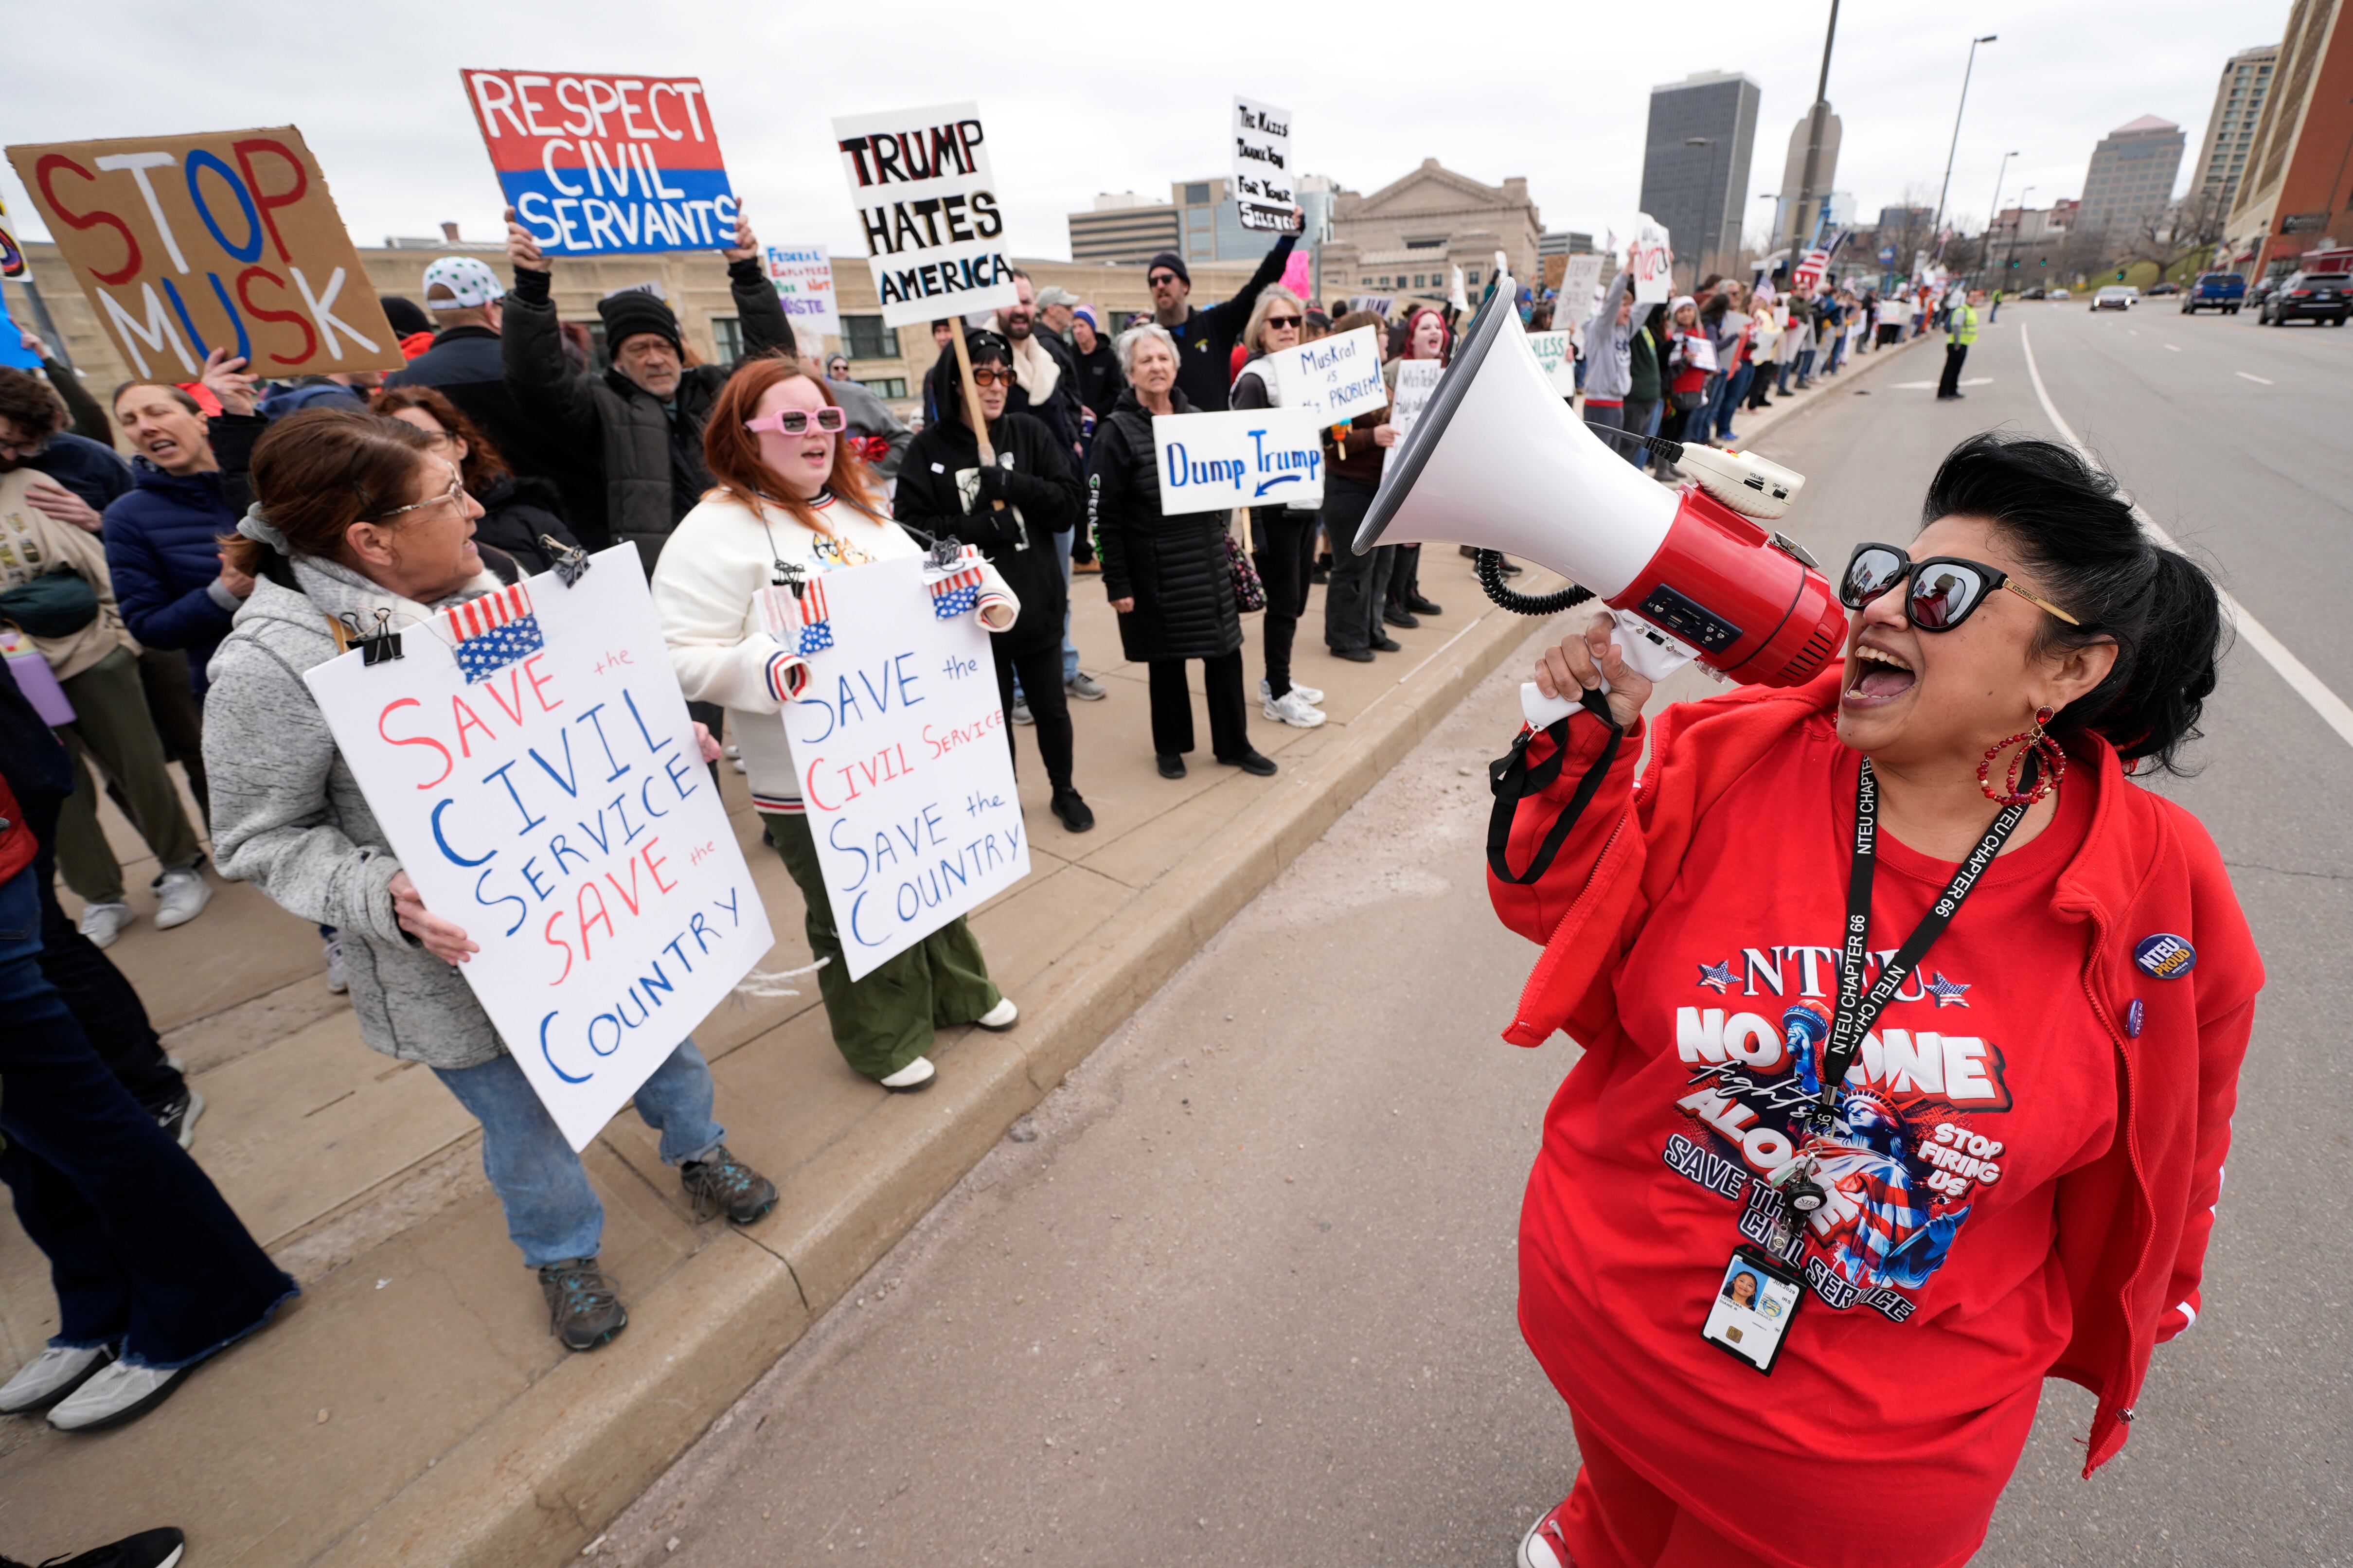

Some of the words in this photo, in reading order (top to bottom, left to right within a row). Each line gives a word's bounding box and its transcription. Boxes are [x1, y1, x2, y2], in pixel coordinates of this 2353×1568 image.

[470, 72, 705, 142] RESPECT
[1239, 105, 1255, 128] THE
[1259, 111, 1287, 137] NAZIS
[542, 138, 685, 199] CIVIL
[838, 120, 984, 187] TRUMP
[1266, 145, 1284, 169] YOU
[36, 139, 307, 285] STOP
[1238, 175, 1259, 196] FOR
[1262, 179, 1291, 202] YOUR
[517, 192, 738, 250] SERVANTS
[857, 190, 1003, 256] HATES
[807, 278, 830, 291] NOT
[880, 253, 1014, 305] AMERICA
[96, 266, 381, 380] MUSK
[1327, 369, 1338, 383] is
[1329, 357, 1383, 410] PROBLEM!
[1166, 442, 1246, 490] Dump
[1248, 429, 1320, 481] Trump
[1749, 472, 1765, 482] VOLUME
[1642, 623, 1658, 633] USB/SD
[378, 652, 564, 790] SAVE
[594, 649, 634, 677] the
[798, 652, 925, 744] SAVE
[942, 656, 979, 682] the
[430, 689, 673, 868] CIVIL
[806, 743, 914, 812] CIVIL
[922, 709, 1005, 759] SERVICE
[475, 752, 698, 937] SERVICE
[829, 802, 948, 892] SAVE
[966, 790, 1006, 819] the
[1857, 816, 1872, 855] NTEU
[852, 823, 1020, 947] COUNTRY
[1946, 835, 1999, 900] CHAPTER
[544, 837, 677, 986] SAVE
[690, 839, 716, 866] the
[1850, 914, 1866, 932] 66
[1935, 898, 1955, 917] 66
[1841, 935, 1863, 1008] CHAPTER
[2138, 937, 2180, 970] NTEU
[2153, 948, 2191, 977] PROUD
[540, 886, 741, 1085] COUNTRY
[1870, 964, 1906, 1004] NTEU
[1676, 1006, 1784, 1068] NO
[1824, 1028, 1999, 1101] ONE
[1831, 1012, 1853, 1055] NTEU
[1687, 1059, 1823, 1119] fights
[1664, 1133, 1747, 1199] SAVE
[1917, 1140, 2000, 1183] FIRING
[1934, 1122, 2003, 1160] STOP
[1798, 1198, 1819, 1207] NTEU
[1719, 1299, 1733, 1309] DIANE
[1772, 1280, 1796, 1295] JUL2029
[1782, 1296, 1792, 1304] IRS
